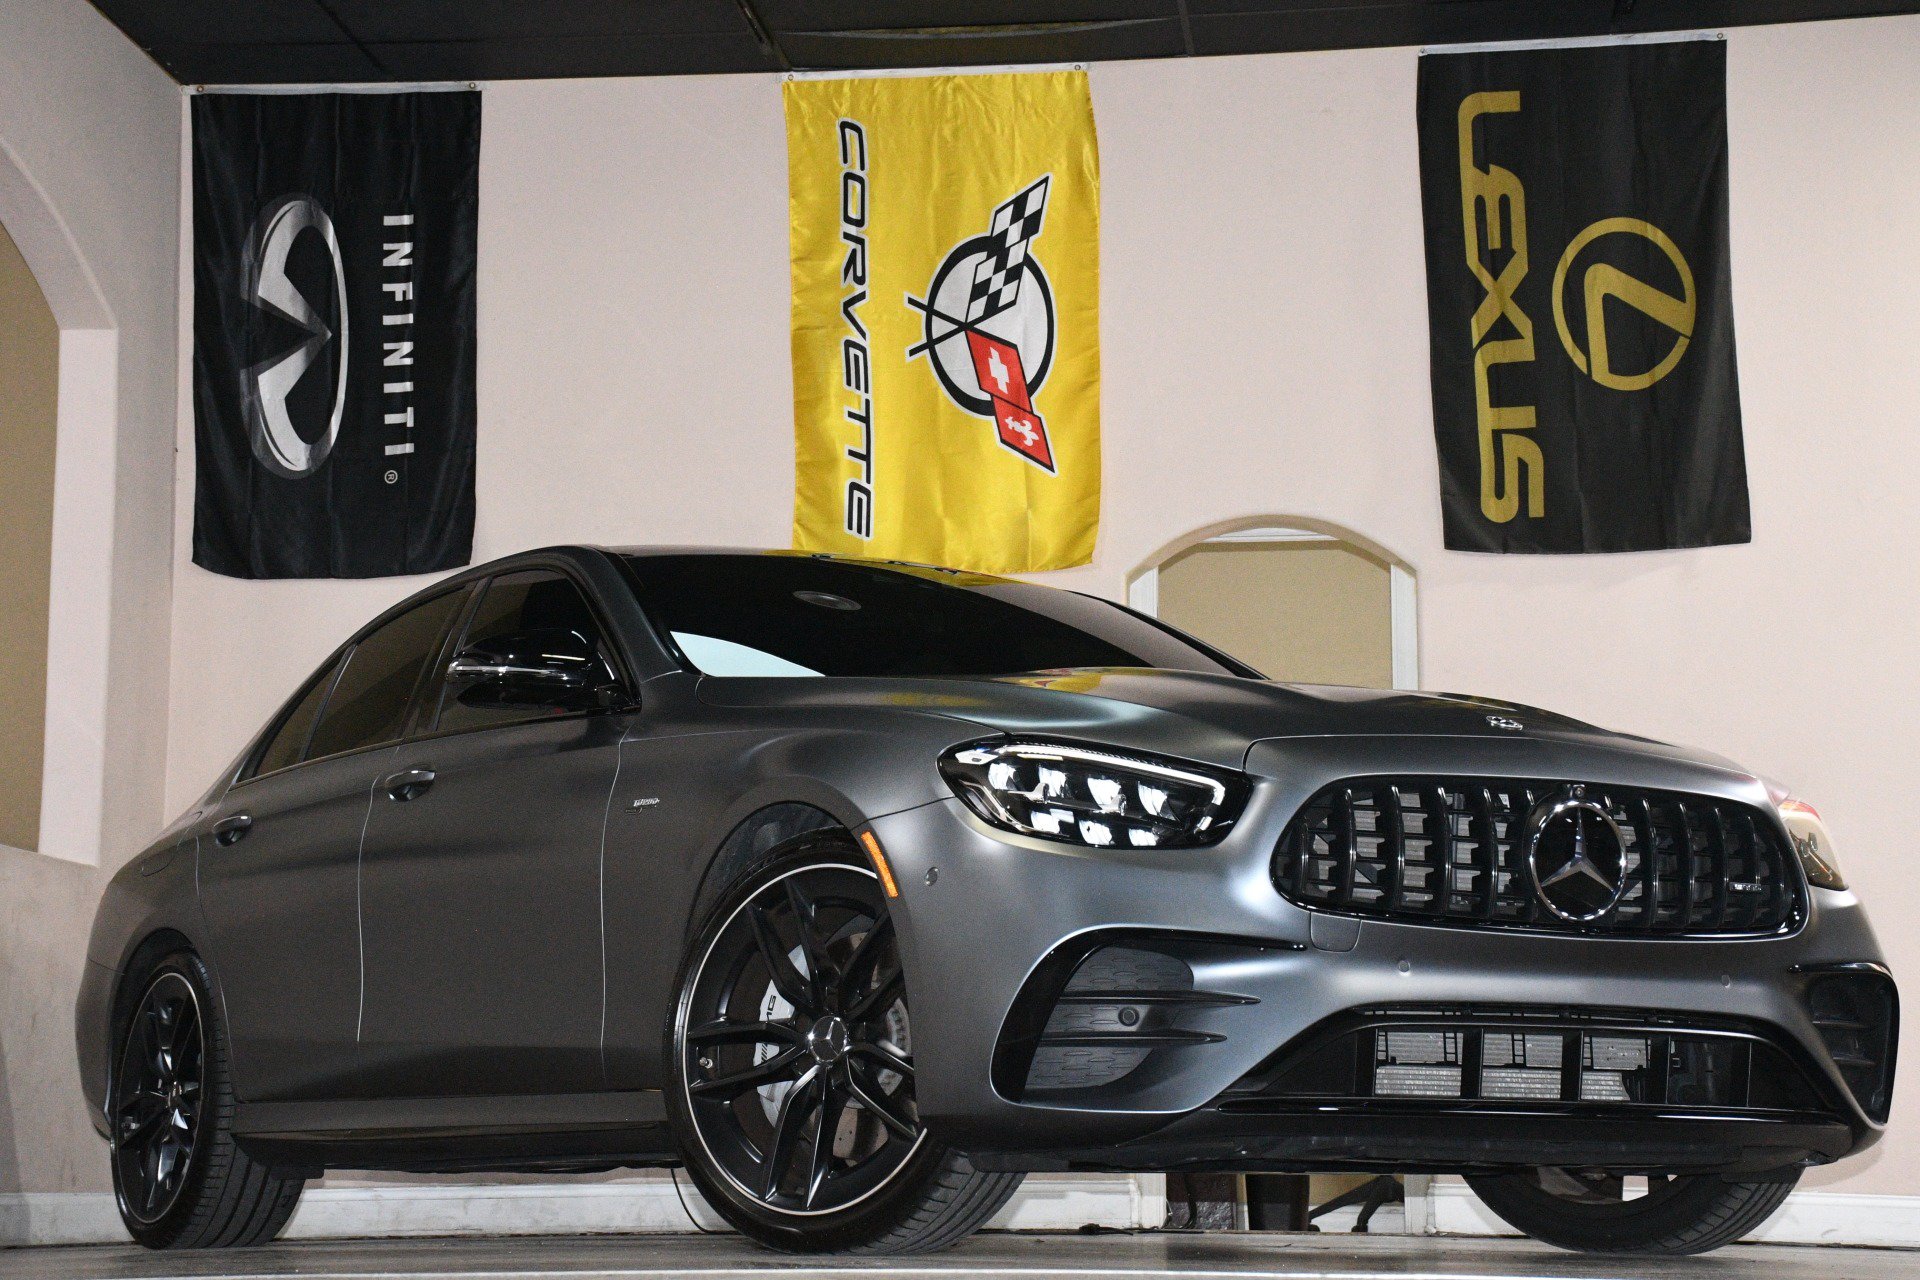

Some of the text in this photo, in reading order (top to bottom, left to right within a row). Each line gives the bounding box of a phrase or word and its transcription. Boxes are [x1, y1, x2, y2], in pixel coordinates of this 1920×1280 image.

[383, 215, 414, 456] INFINITI
[839, 120, 872, 538] CORVETTE
[1458, 91, 1545, 524] LEXUS
